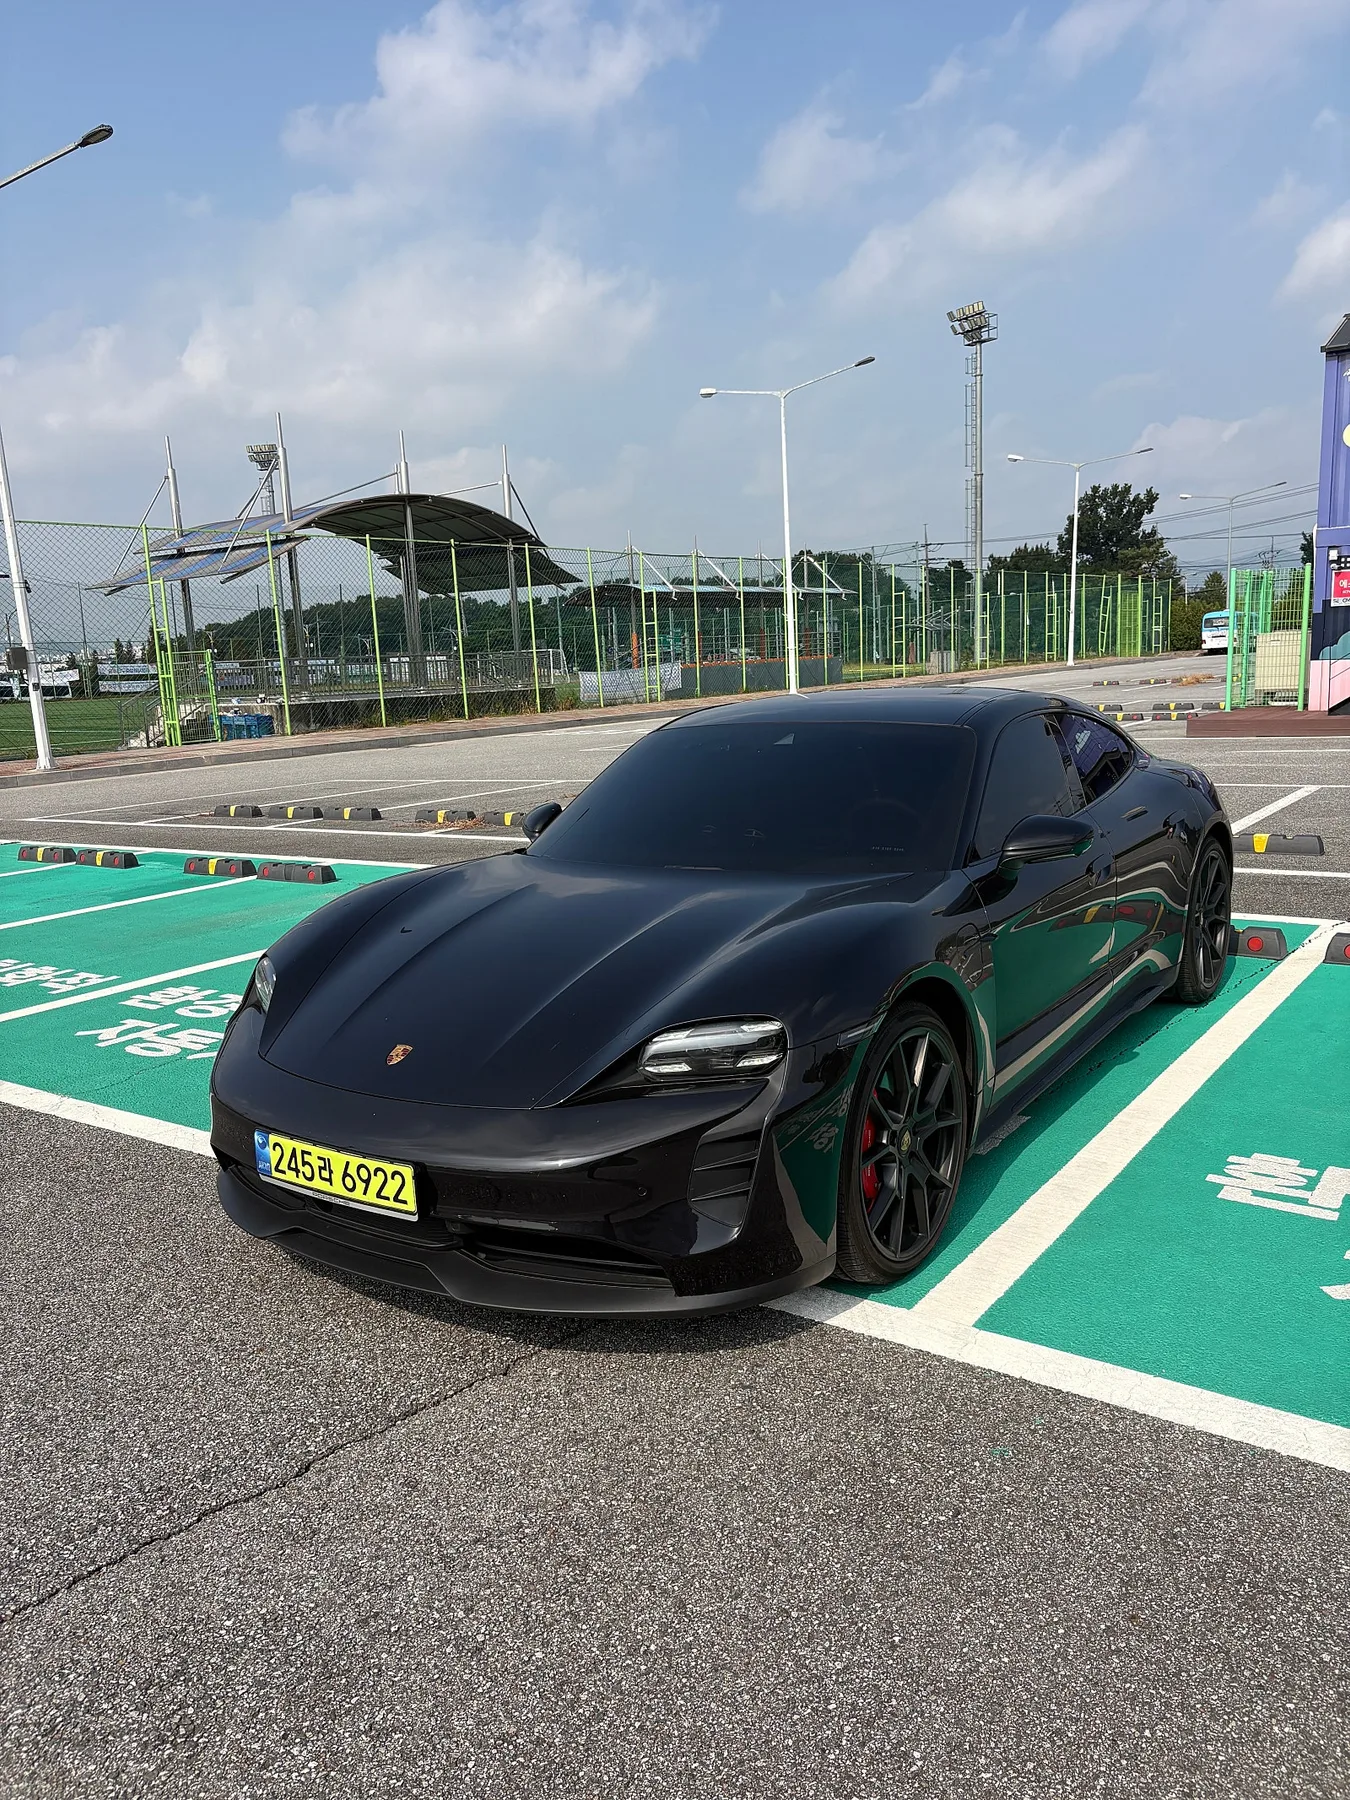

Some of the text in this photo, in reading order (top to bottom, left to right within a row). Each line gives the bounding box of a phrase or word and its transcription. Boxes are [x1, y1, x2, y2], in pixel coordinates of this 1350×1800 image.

[74, 1018, 225, 1060] 자동
[272, 1142, 409, 1205] 245라 6922
